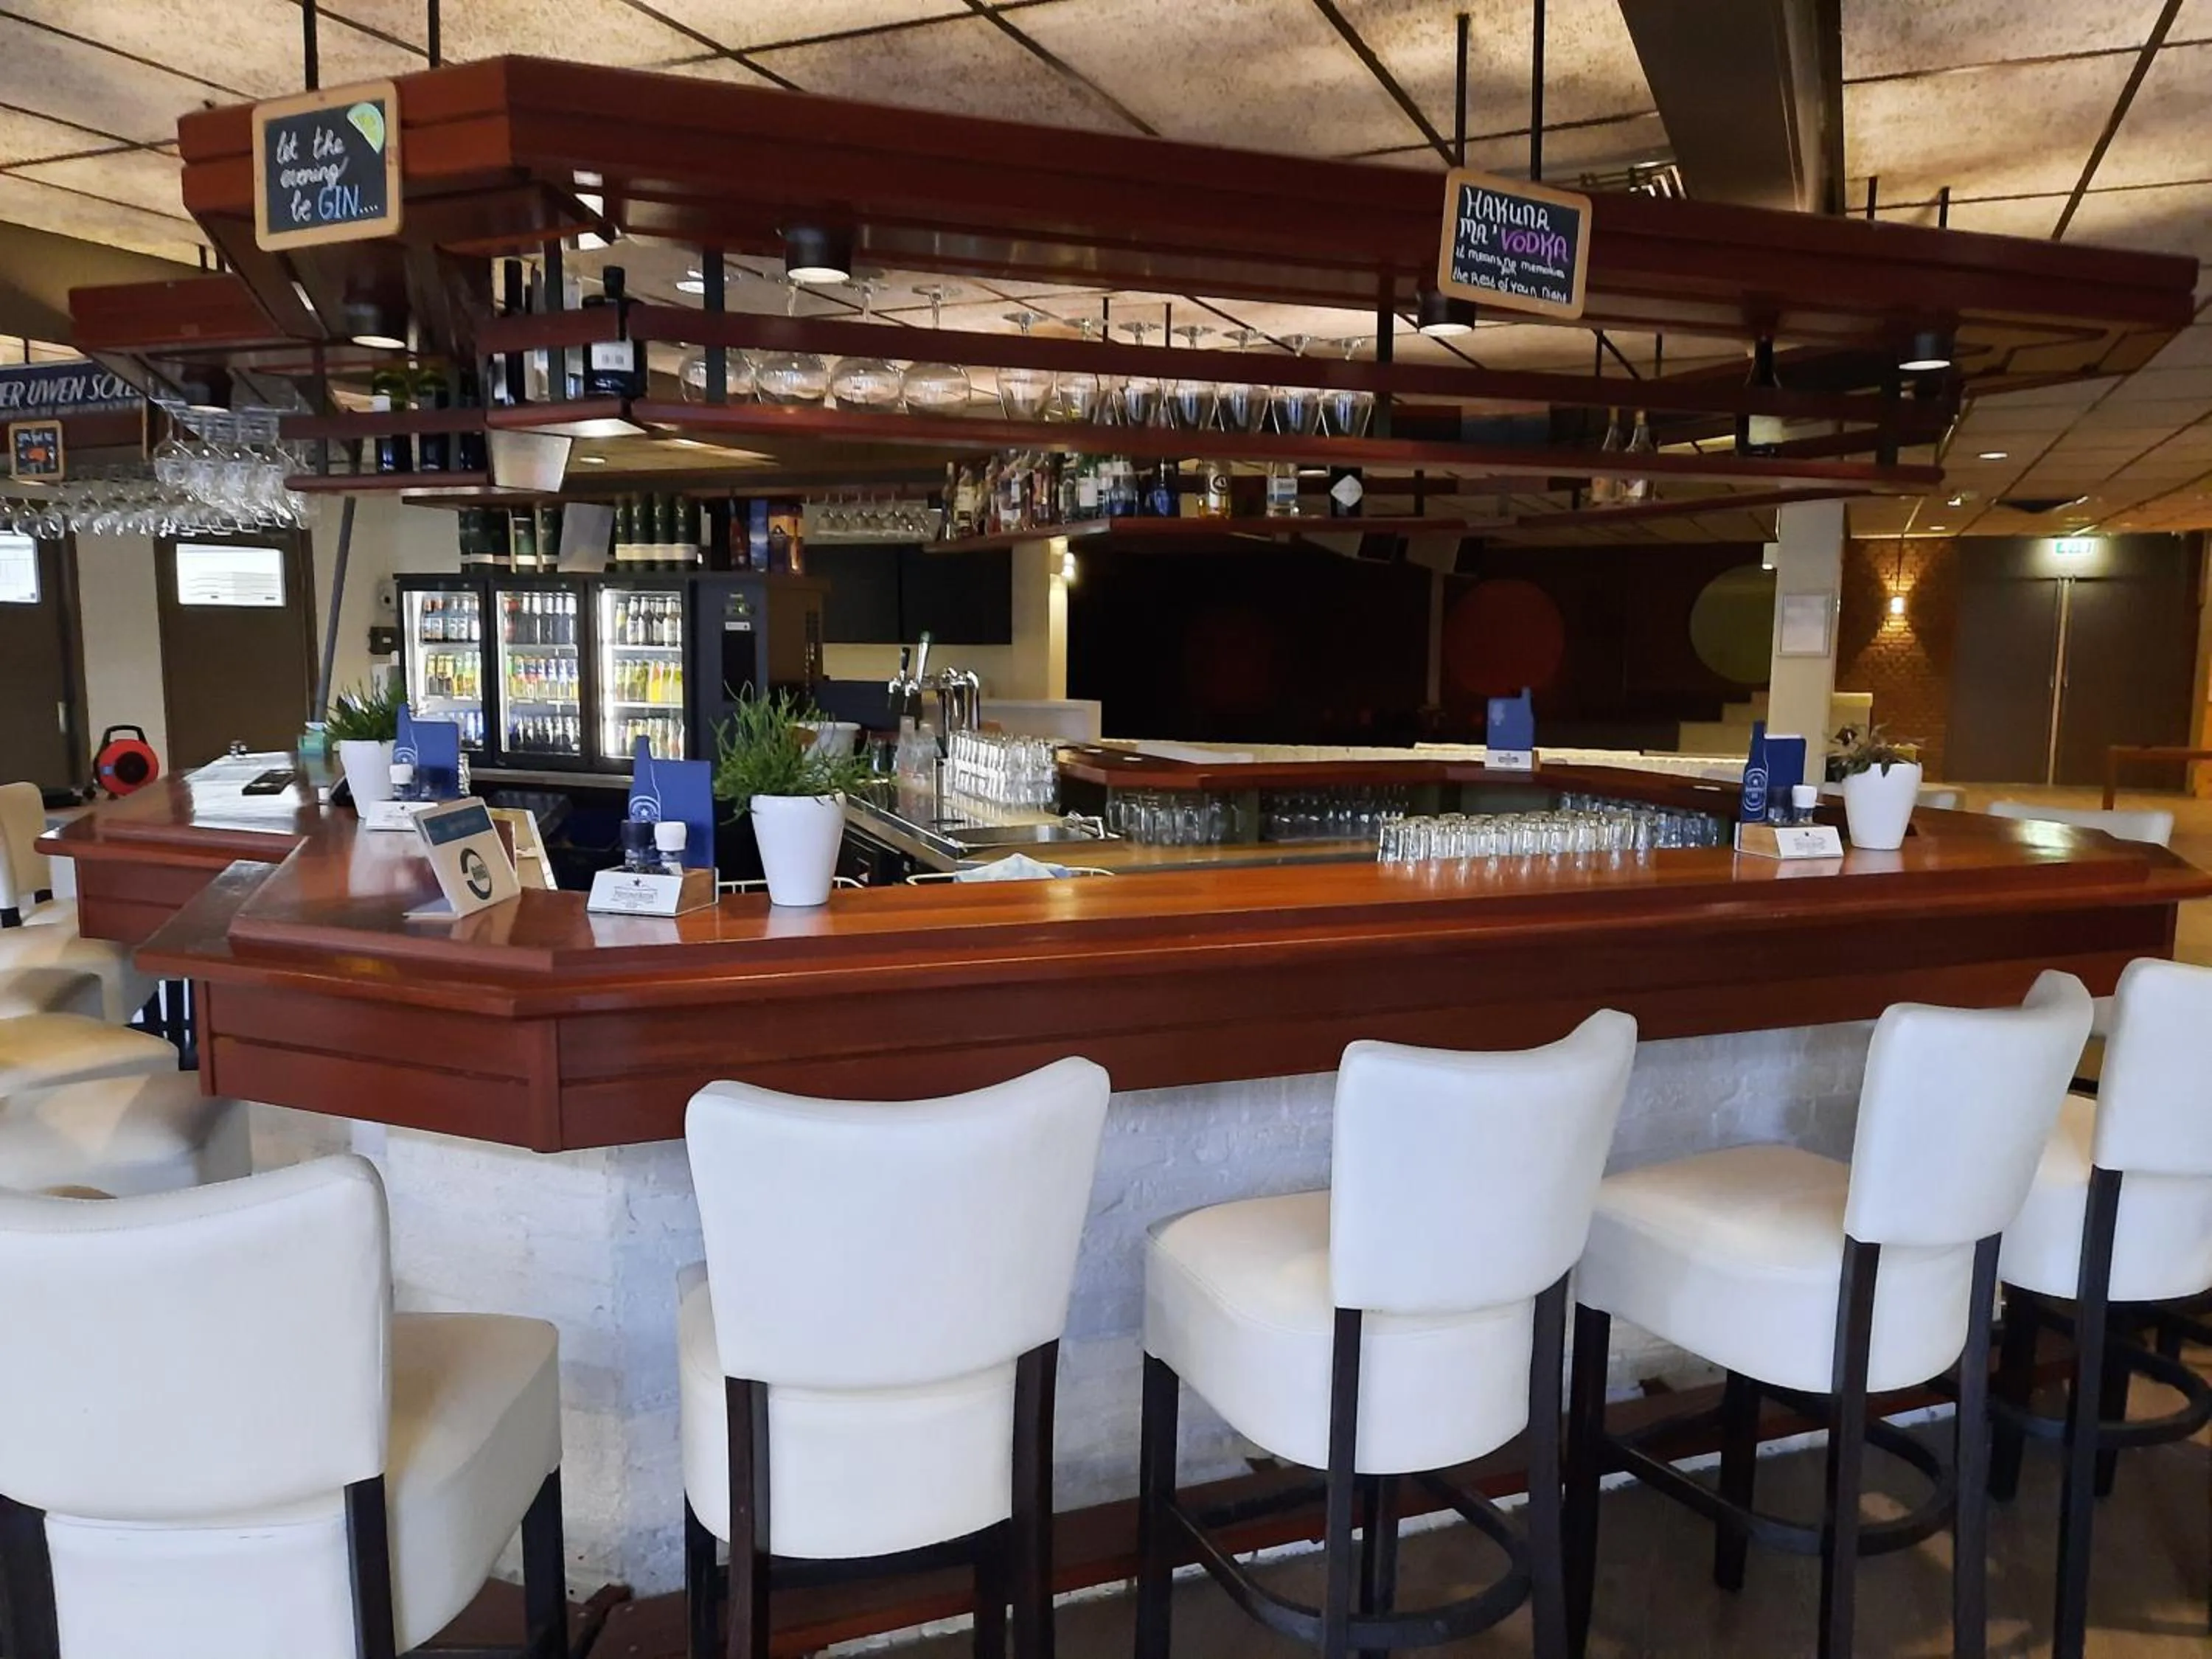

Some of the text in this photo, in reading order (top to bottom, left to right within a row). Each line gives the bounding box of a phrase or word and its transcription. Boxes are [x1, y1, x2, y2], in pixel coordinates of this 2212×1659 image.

[313, 125, 346, 159] the
[279, 156, 349, 189] evening
[290, 189, 313, 223] be
